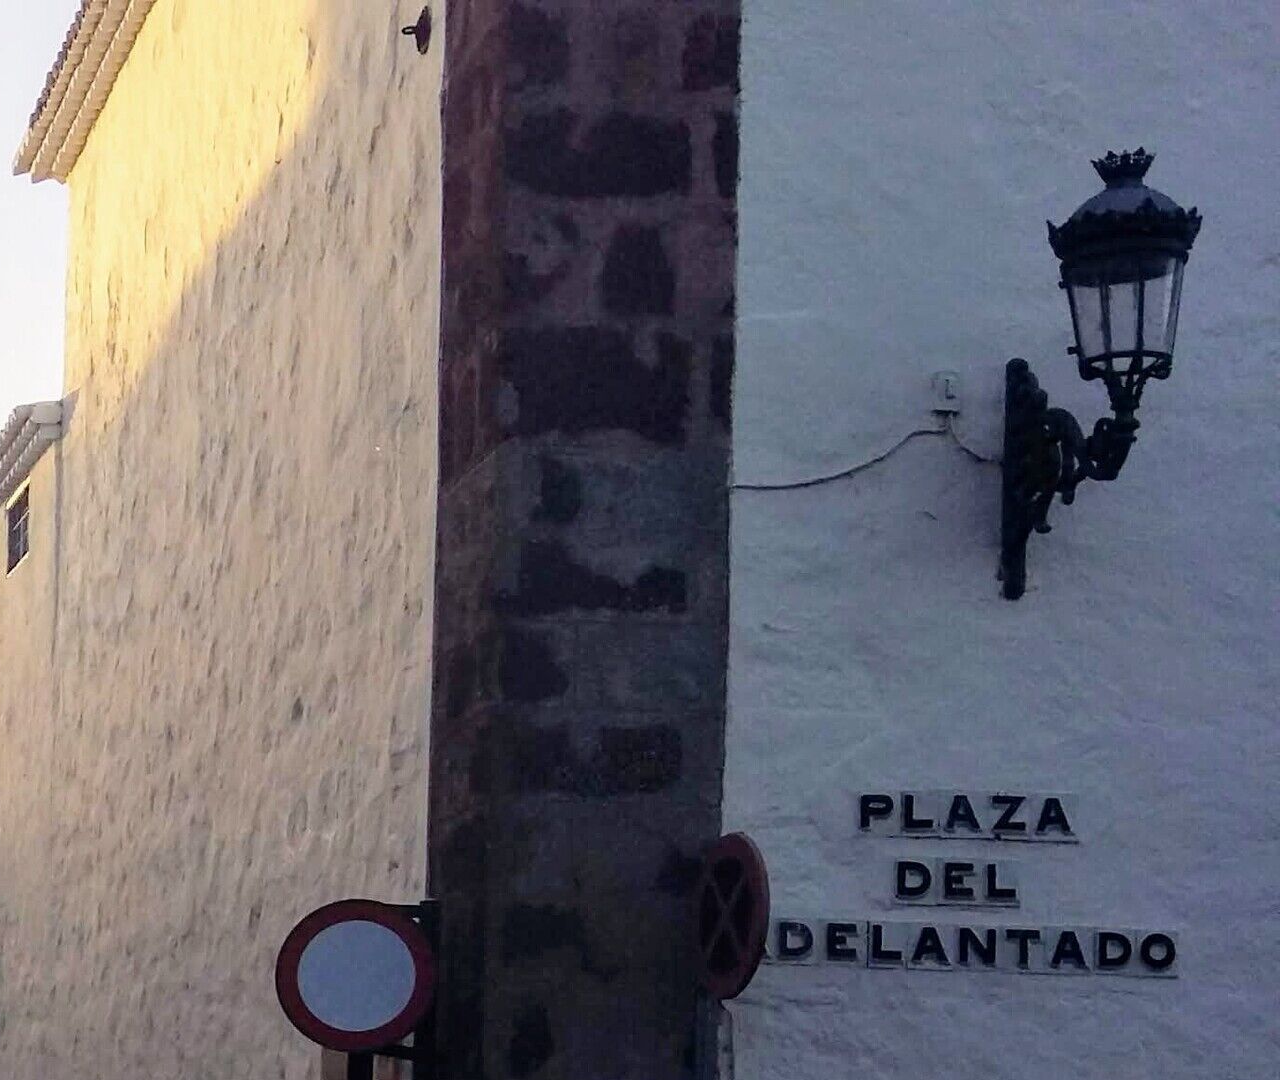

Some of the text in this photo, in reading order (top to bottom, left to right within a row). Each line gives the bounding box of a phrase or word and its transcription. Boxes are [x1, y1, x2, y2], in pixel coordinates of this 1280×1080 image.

[859, 794, 1072, 834] PLAZA
[895, 860, 1018, 899] DEL
[764, 921, 1177, 970] DELANTADO
